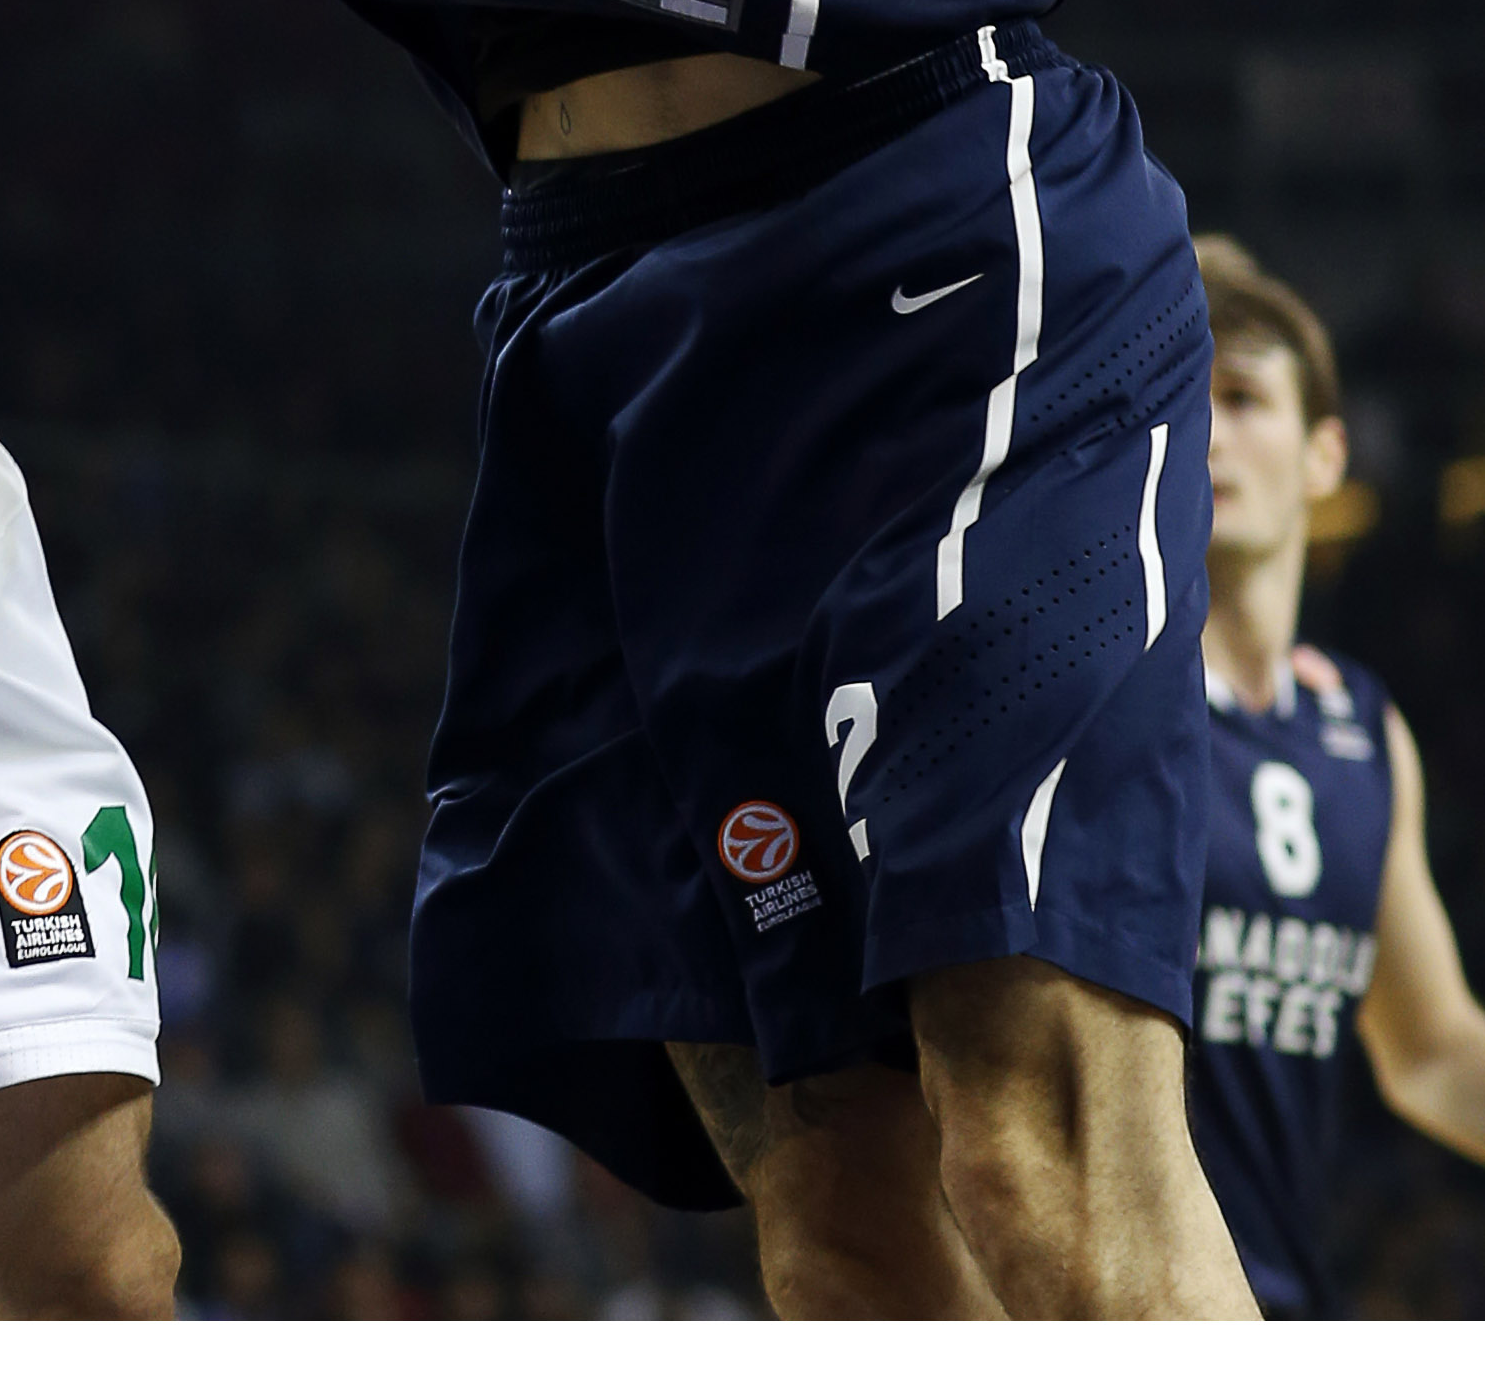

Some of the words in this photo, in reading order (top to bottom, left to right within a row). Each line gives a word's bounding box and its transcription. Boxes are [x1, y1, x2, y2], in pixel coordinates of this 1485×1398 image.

[1250, 760, 1323, 897] 8
[81, 806, 160, 981] 1
[745, 870, 813, 907] TURKISH
[754, 884, 817, 922] AIRLINES
[11, 914, 81, 934] TURKISH
[16, 929, 85, 949] AIRLINES
[17, 943, 87, 960] EUROLEAGUE
